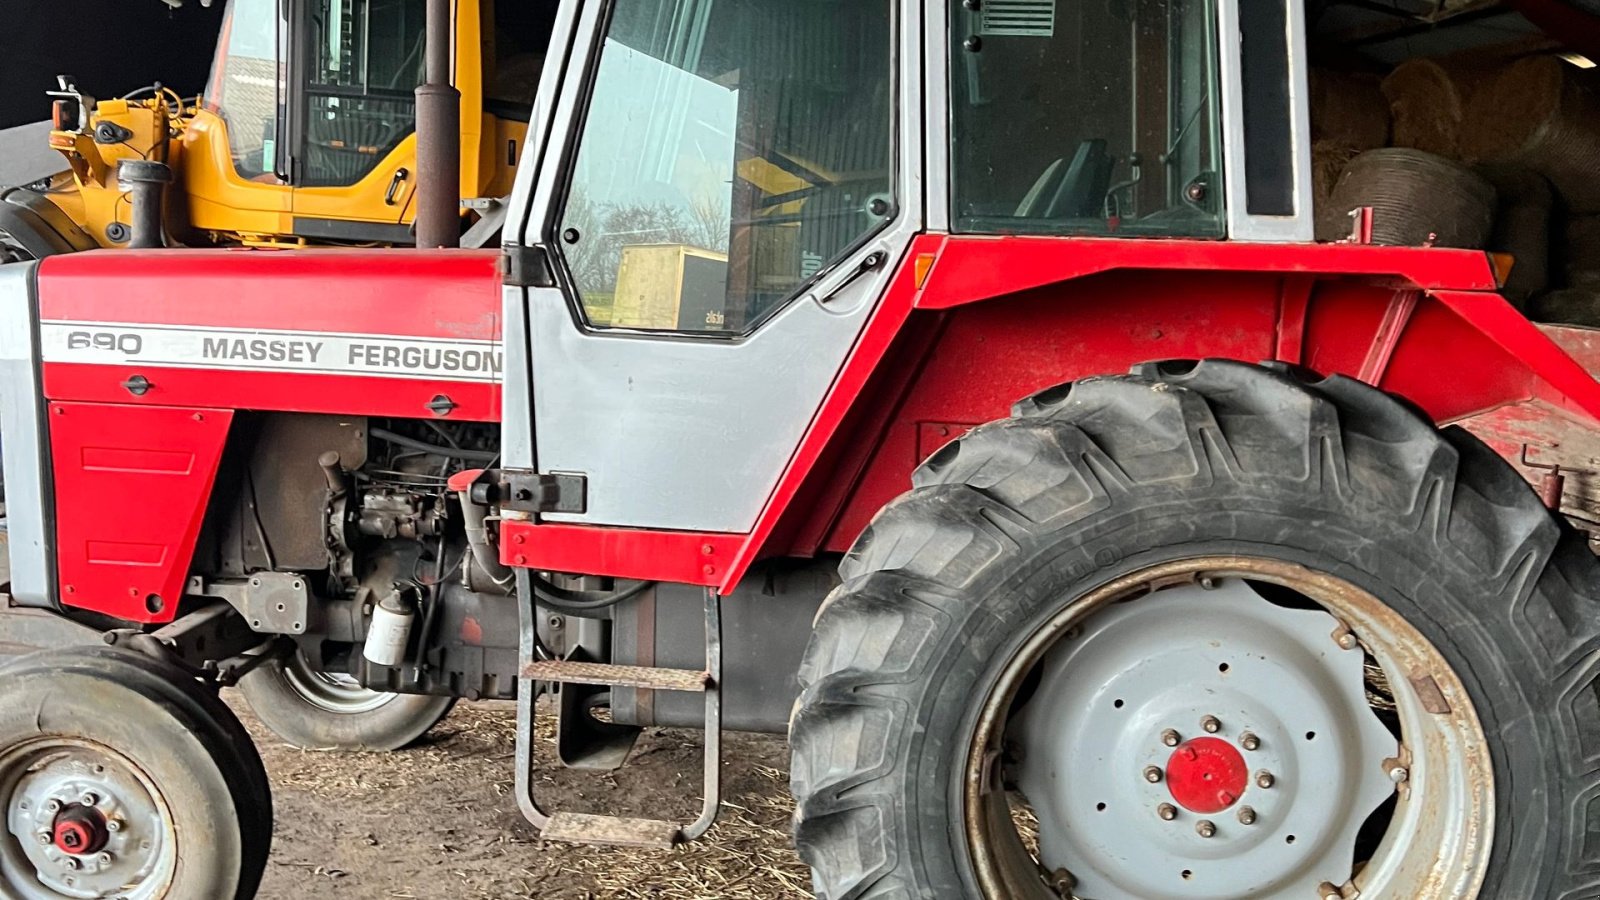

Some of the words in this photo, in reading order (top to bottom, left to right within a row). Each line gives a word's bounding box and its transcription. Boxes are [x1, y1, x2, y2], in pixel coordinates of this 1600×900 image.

[68, 331, 142, 355] 690
[203, 338, 324, 363] MASSEY
[348, 344, 502, 373] FERGUSON
